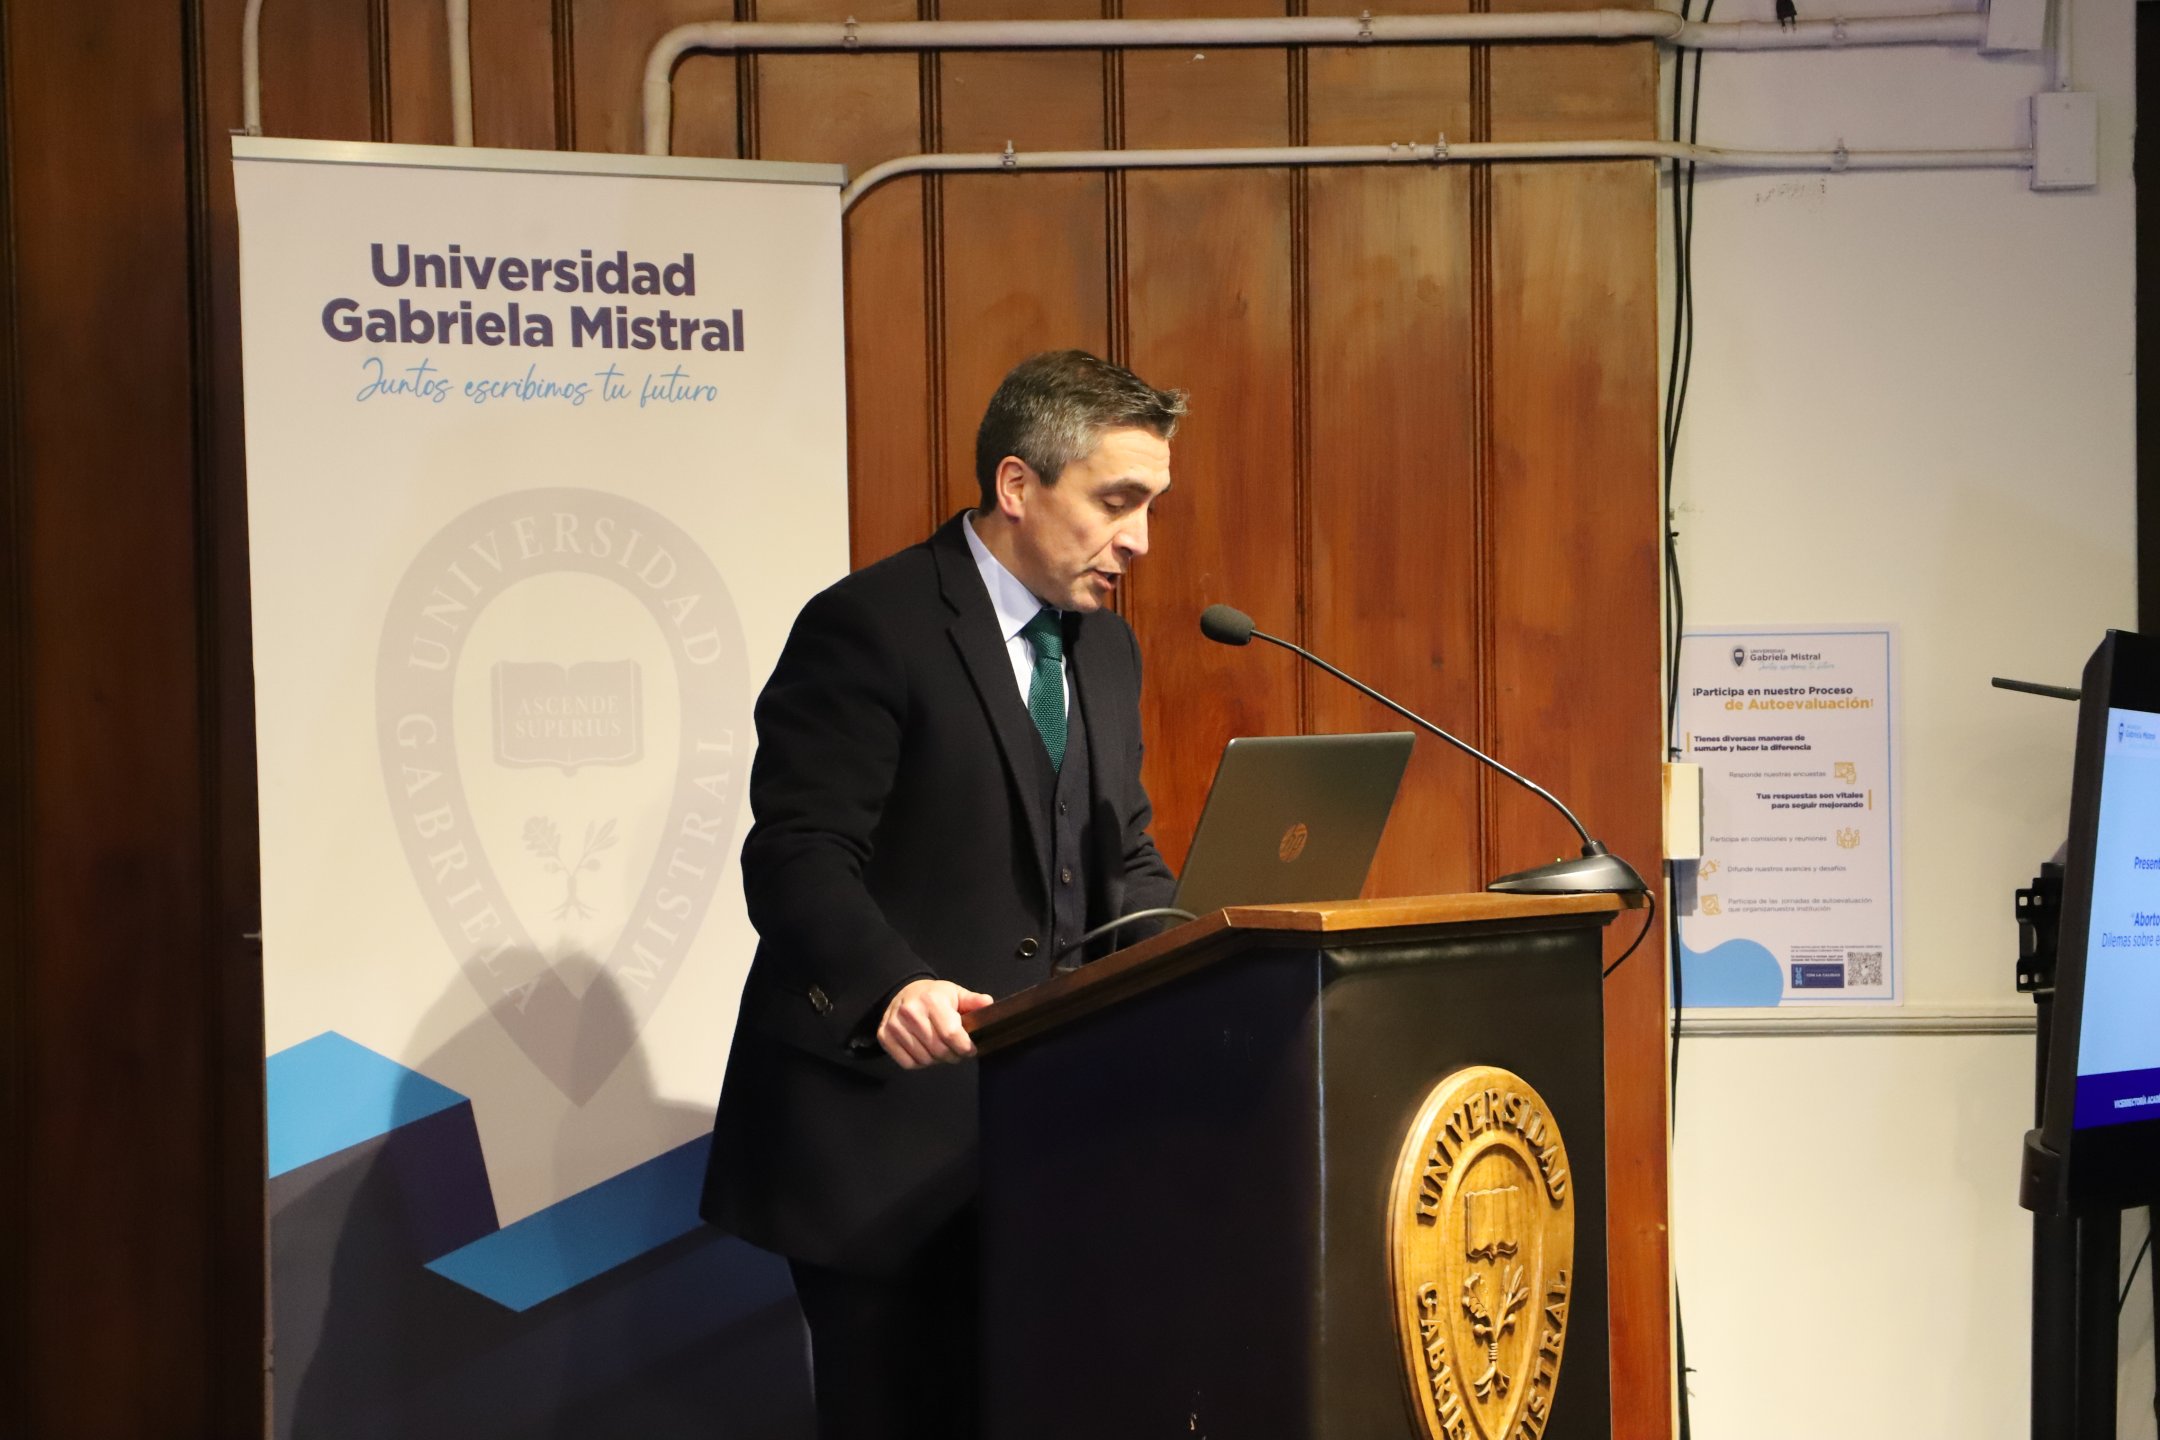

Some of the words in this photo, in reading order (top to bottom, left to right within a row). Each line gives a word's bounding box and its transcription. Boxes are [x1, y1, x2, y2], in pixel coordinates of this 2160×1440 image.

[371, 243, 695, 296] Universidad
[322, 298, 554, 348] Gabriela
[570, 306, 744, 352] Mistral
[356, 358, 454, 403] Juntos
[464, 364, 594, 406] escribimos
[594, 364, 631, 401] tu
[640, 365, 718, 408] futuro
[408, 511, 722, 673] UNIVERSIDAD
[516, 695, 619, 717] ASCENDE
[1692, 688, 1744, 697] ¡Participa
[1764, 688, 1806, 696] nuestro
[1809, 686, 1853, 695] Proceso
[1724, 699, 1743, 710] de
[1748, 697, 1874, 710] Autoevaluación!
[515, 717, 621, 739] SUPERIUS
[1792, 802, 1817, 810] seguir
[1819, 801, 1864, 810] mejorando
[396, 712, 541, 1015] GABRIELA
[616, 728, 735, 993] MISTRAL
[2101, 932, 2132, 948] Dilemas
[2133, 932, 2154, 947] sobre
[1417, 1088, 1567, 1226] UNIVERSIDAD
